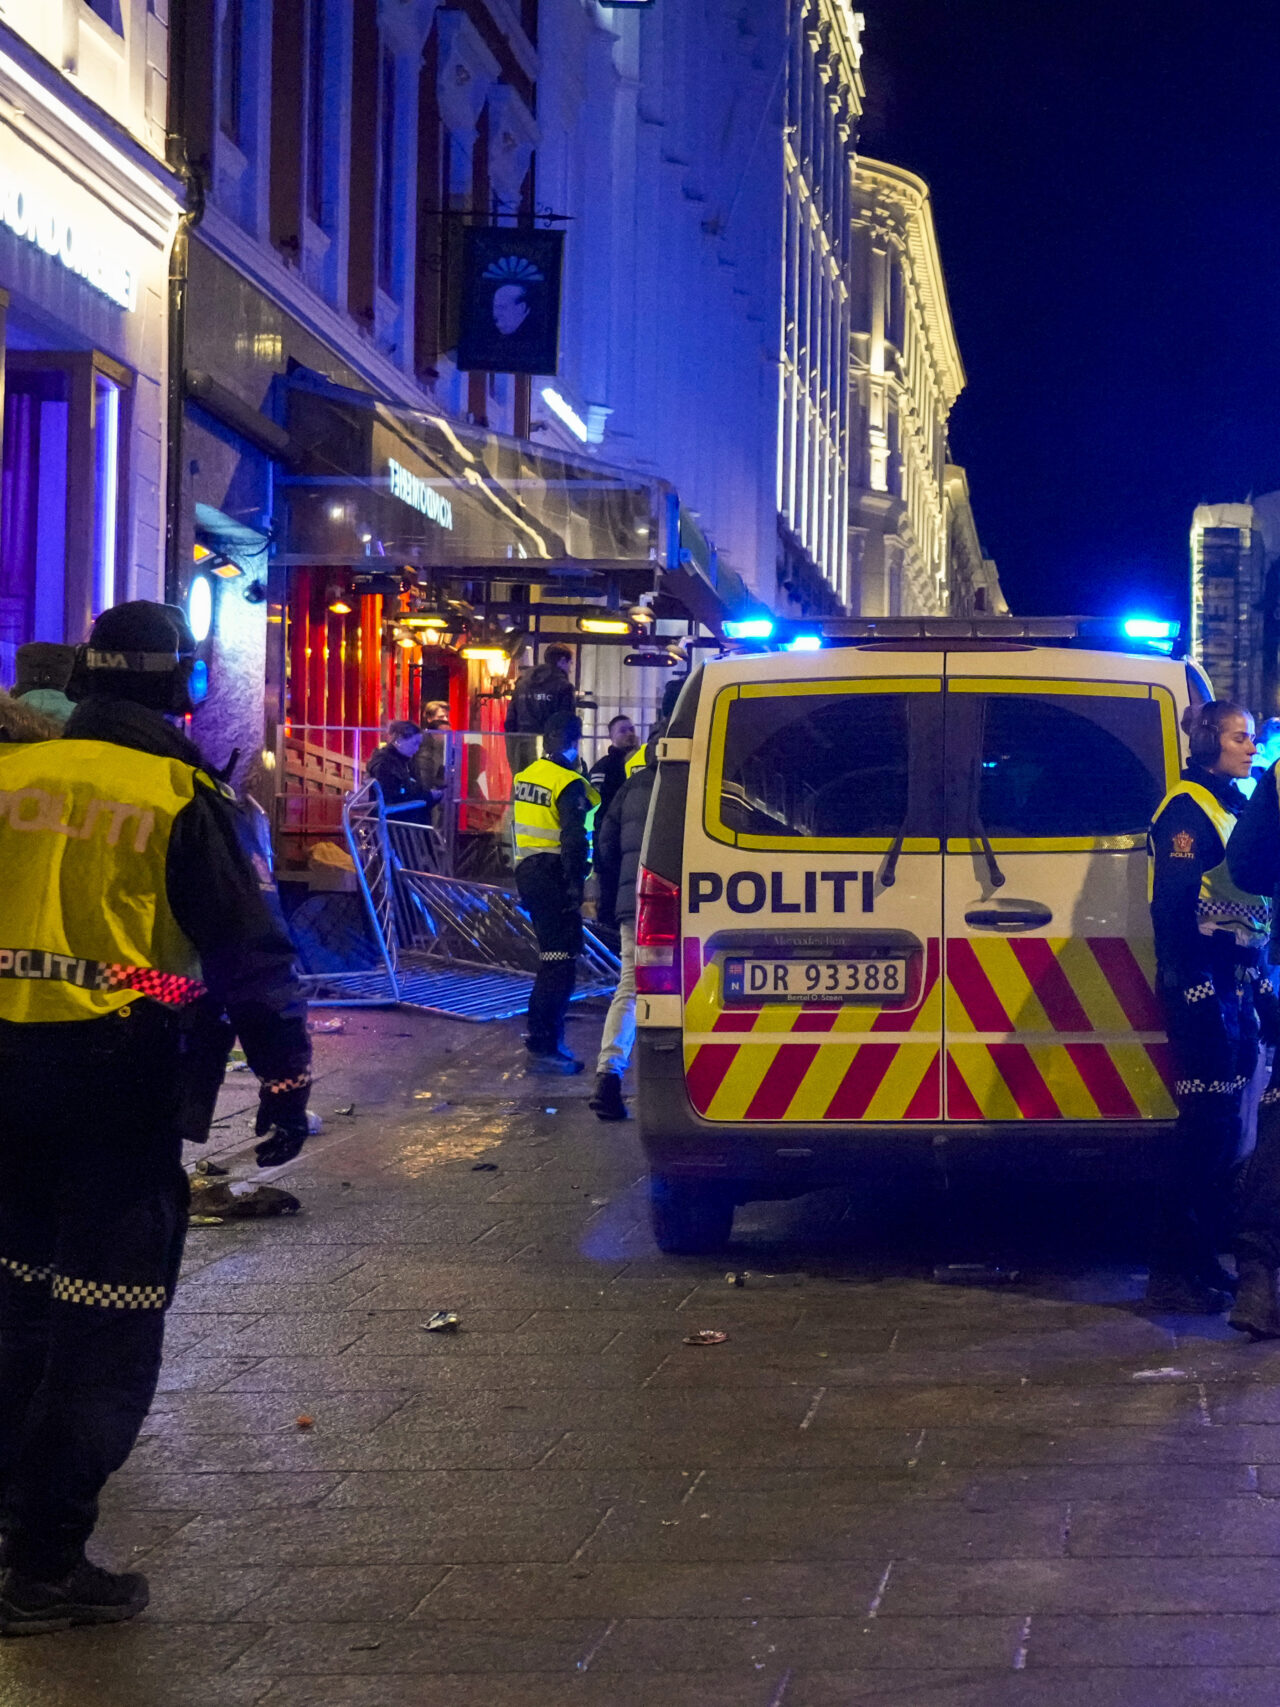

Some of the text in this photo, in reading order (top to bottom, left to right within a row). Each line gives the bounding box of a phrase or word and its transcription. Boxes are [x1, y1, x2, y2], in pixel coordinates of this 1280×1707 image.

[688, 871, 874, 914] POLITI
[731, 981, 740, 990] N
[751, 964, 899, 991] DR 93388
